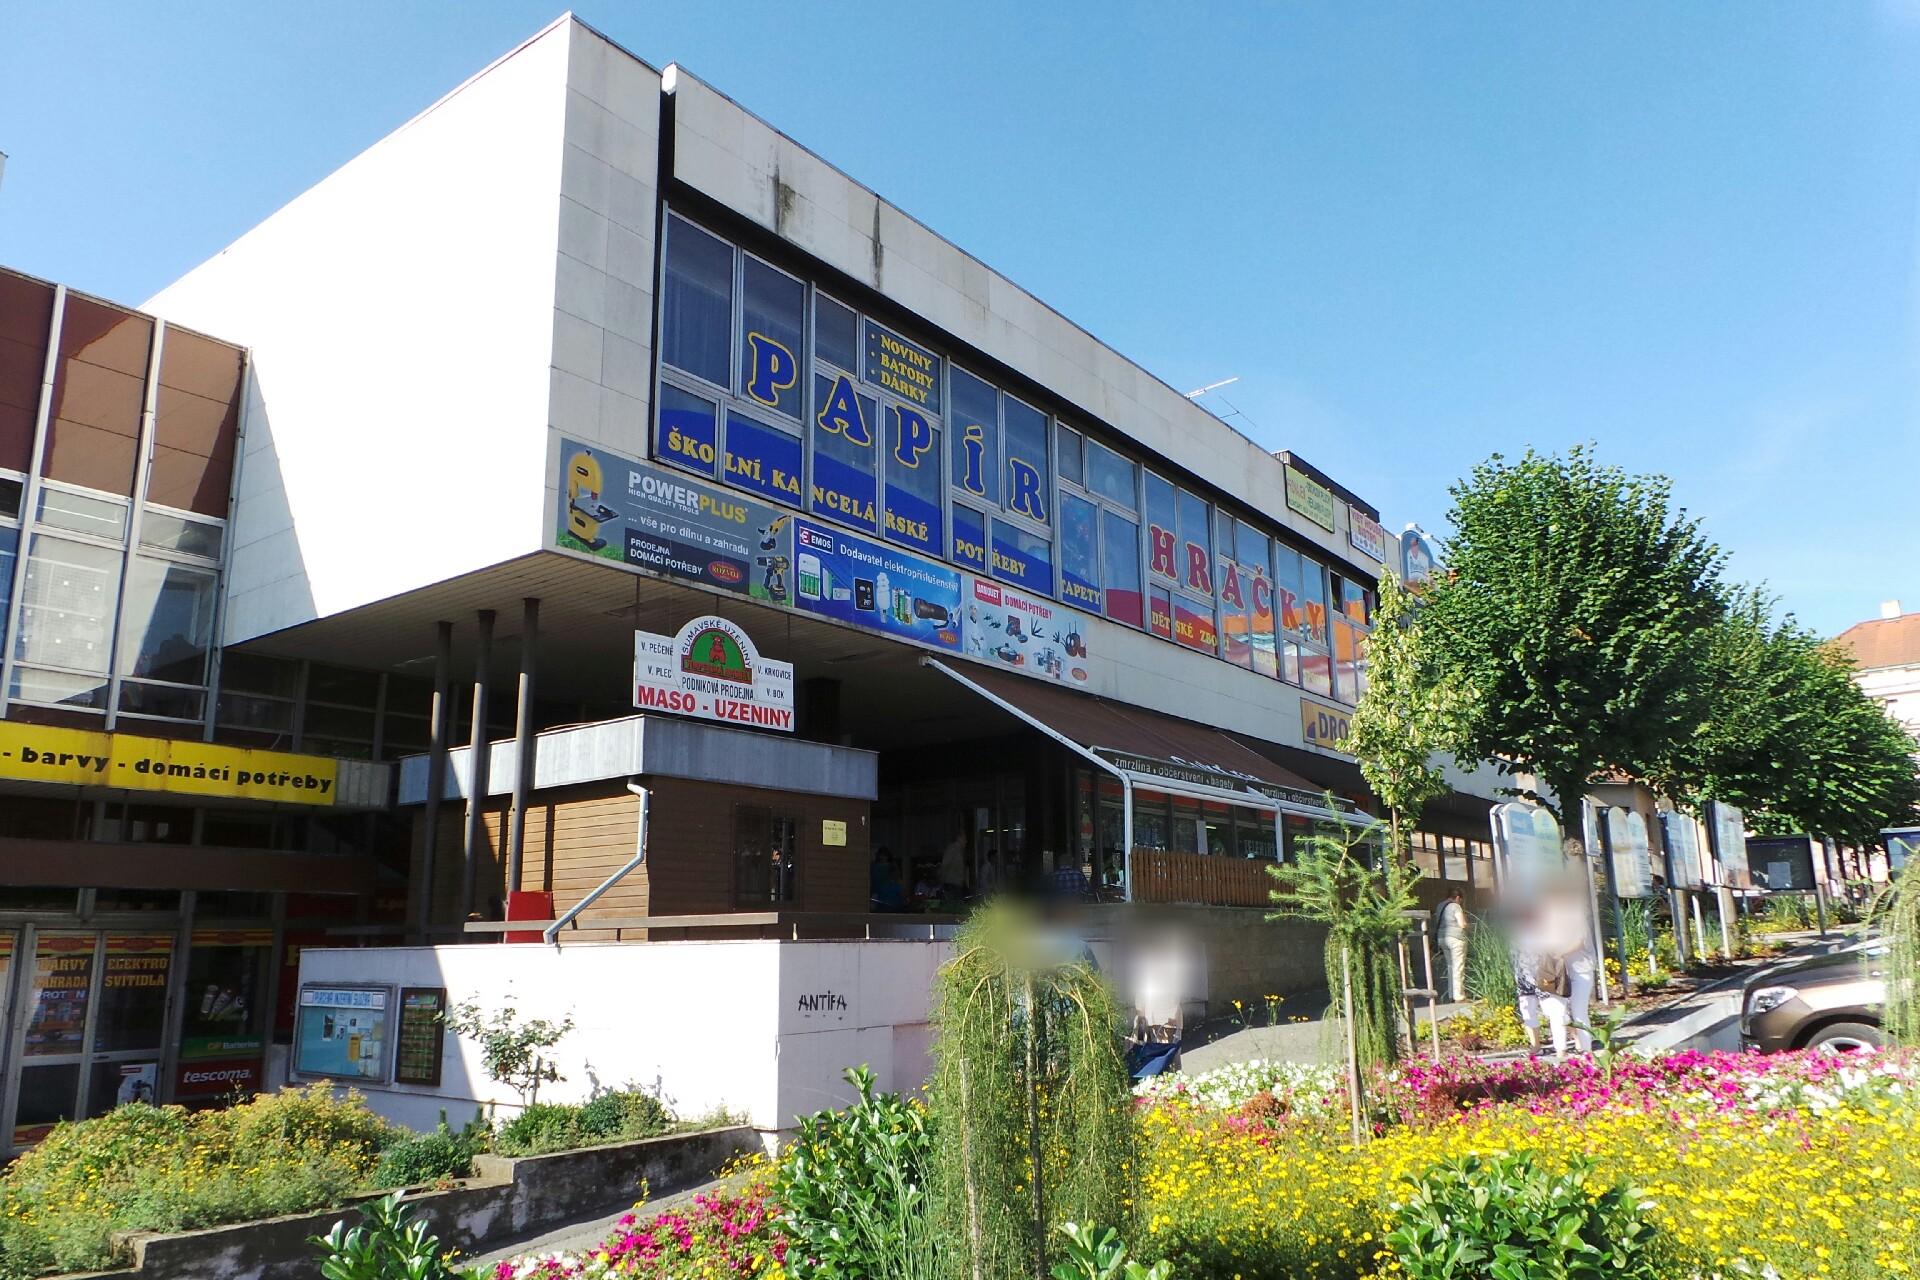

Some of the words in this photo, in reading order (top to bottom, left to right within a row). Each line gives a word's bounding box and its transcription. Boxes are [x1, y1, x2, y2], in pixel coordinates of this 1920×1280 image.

[880, 334, 932, 371] NOVINY
[880, 352, 934, 390] BATOHY
[880, 372, 928, 404] DÁRKY
[747, 331, 1046, 522] PAPÍR
[628, 487, 645, 500] HIGH
[648, 493, 677, 509] QUALITY
[679, 503, 699, 516] TOOLS
[640, 516, 657, 529] vše
[660, 522, 677, 536] pro
[679, 522, 703, 543] dílnu
[704, 536, 711, 544] a
[712, 537, 749, 556] zahradu
[772, 467, 930, 543] KANCELÁŘSKÉ
[955, 538, 1027, 578] POTŘEBY
[630, 537, 671, 556] PRODEJNA
[810, 535, 832, 551] EMOS
[840, 544, 883, 568] Dodavatel
[630, 548, 663, 567] DOMÁCÍ
[665, 556, 703, 576] POTŘEBY
[1150, 523, 1325, 641] HRAČKY
[1004, 594, 1028, 612] DOMÁCÍ
[724, 624, 751, 668] UZENINY
[1200, 628, 1230, 651] ZBOÍ
[655, 668, 672, 679] PLEC
[764, 668, 792, 681] KRKOVICE
[681, 675, 720, 694] PODNIKOVÁ
[720, 683, 754, 701] PRODEJNA
[773, 688, 785, 699] BOK
[637, 685, 696, 712] MASO
[714, 698, 792, 729] UZENINY
[21, 746, 109, 774] barvy
[134, 757, 230, 782] domácí
[236, 769, 333, 794] potřeby
[1114, 757, 1151, 774] zmrzlina
[1210, 775, 1235, 791] bagety
[37, 957, 88, 971] BARVY
[107, 957, 169, 971] ELEKTRO
[104, 974, 165, 988] SVITIDLA
